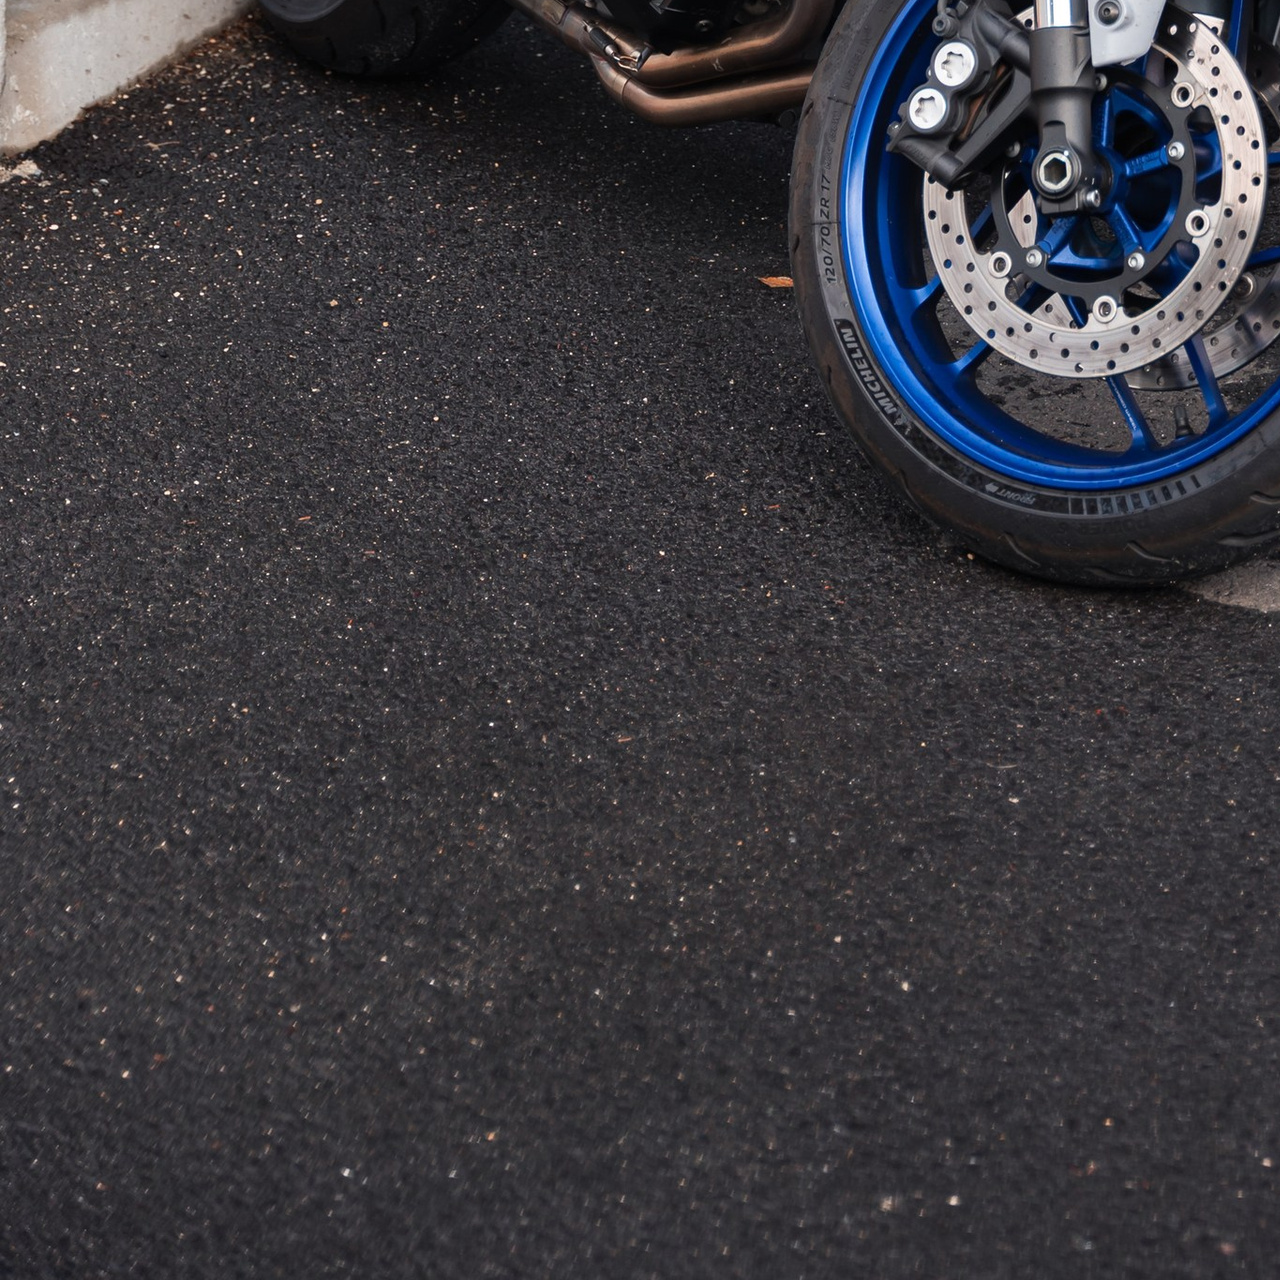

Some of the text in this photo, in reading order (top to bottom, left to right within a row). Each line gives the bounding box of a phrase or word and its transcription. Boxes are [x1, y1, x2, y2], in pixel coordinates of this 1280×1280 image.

[820, 173, 832, 192] 17
[819, 197, 831, 221] ZR
[819, 224, 837, 284] 120/70
[840, 327, 898, 415] MICHELIN
